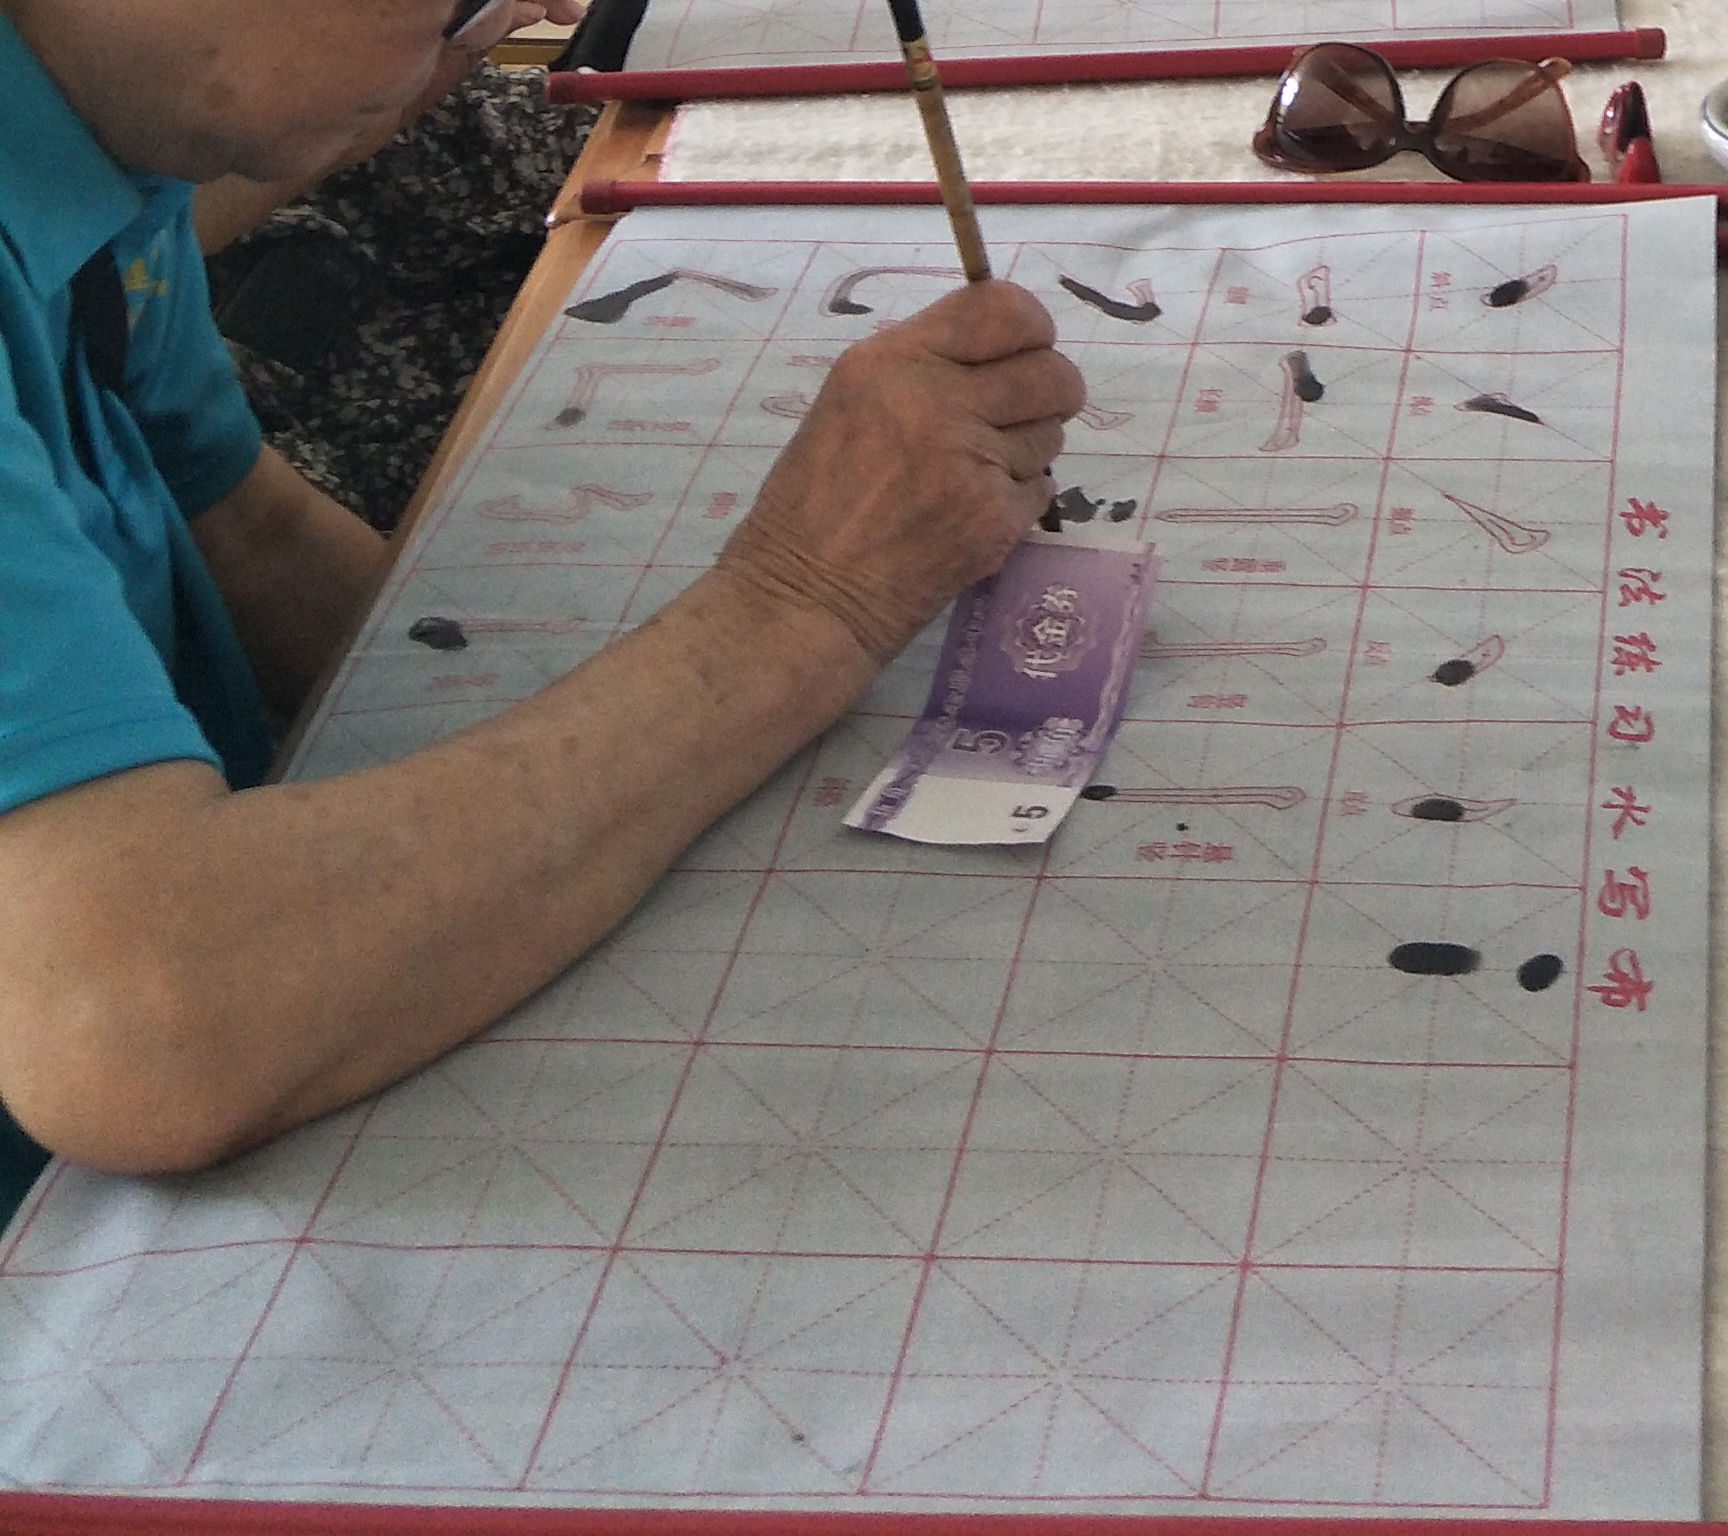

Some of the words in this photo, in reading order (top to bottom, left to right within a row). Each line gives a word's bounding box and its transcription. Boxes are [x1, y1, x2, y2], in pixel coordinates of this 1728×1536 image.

[950, 728, 1009, 756] 5
[1586, 496, 1671, 1013] 书法练习水写布
